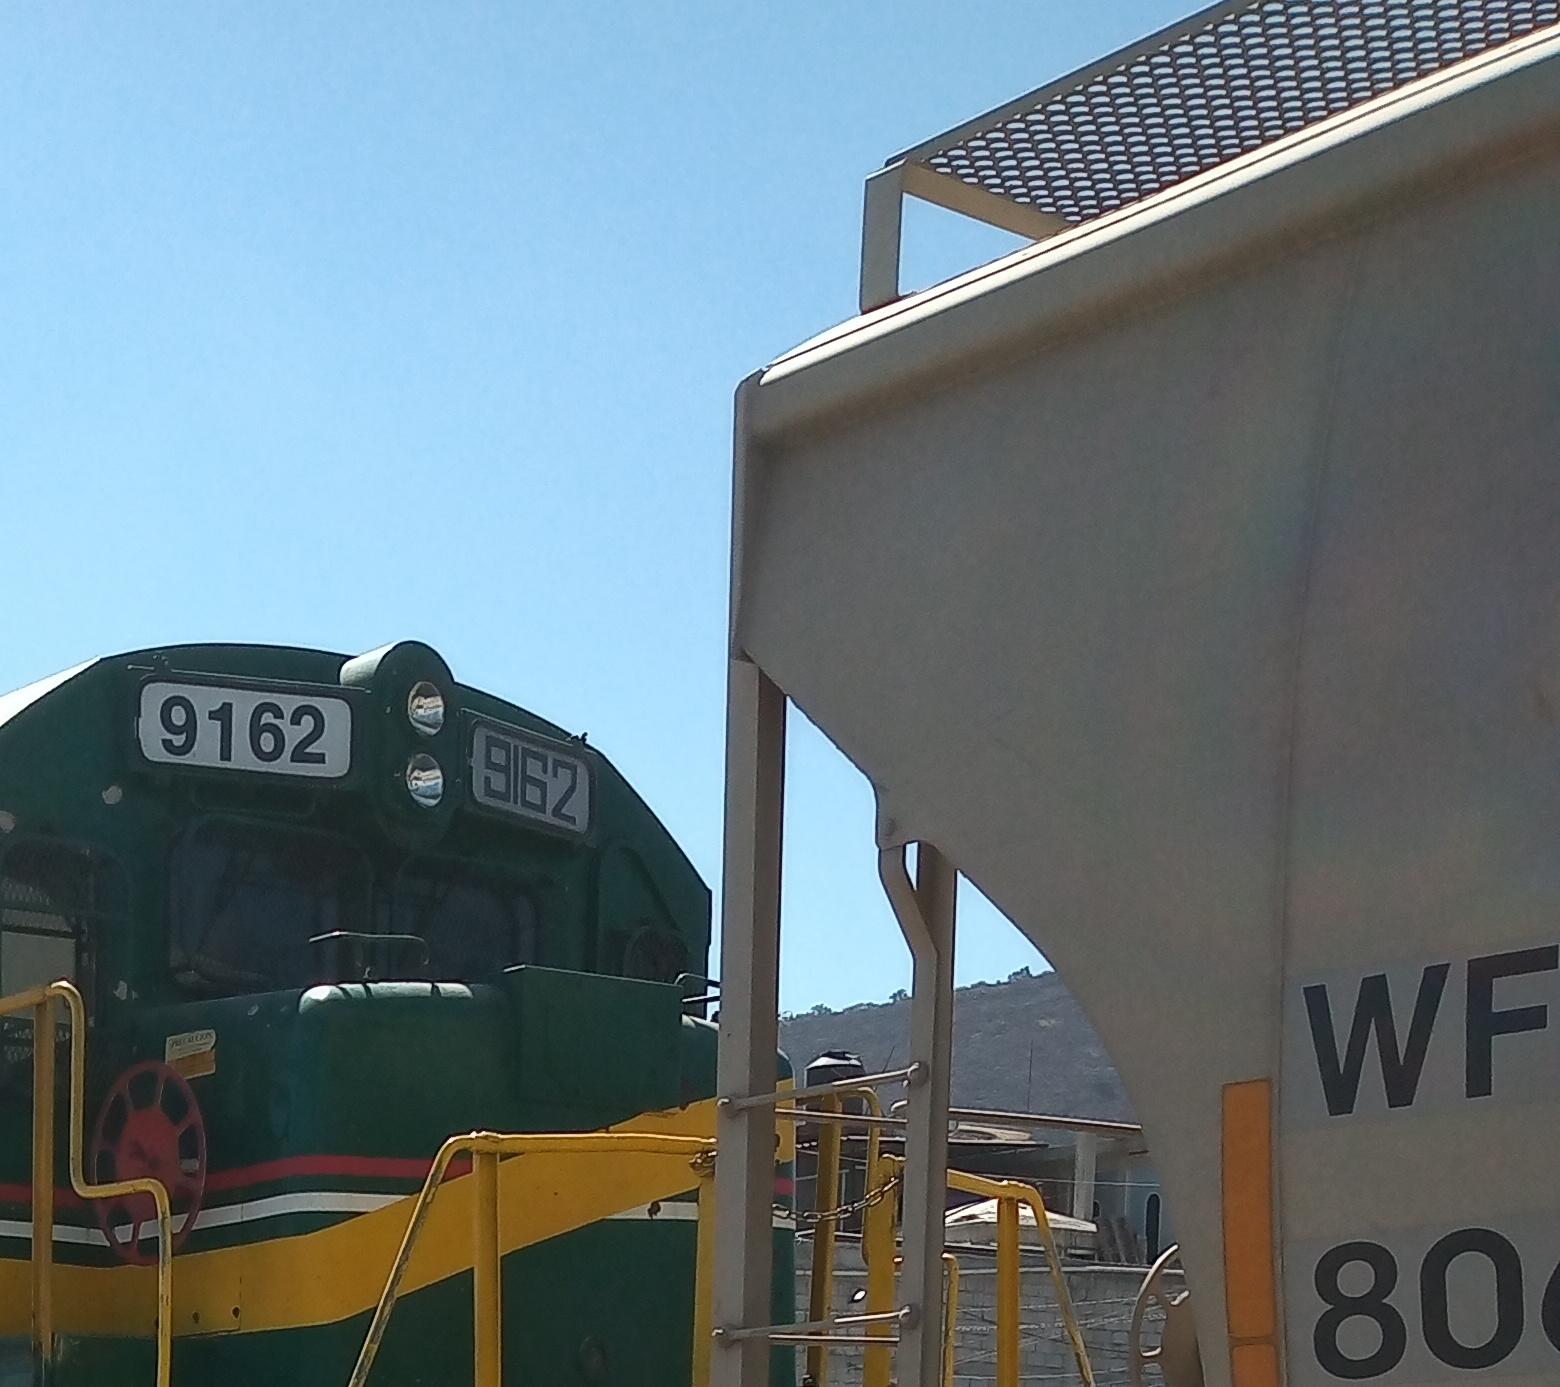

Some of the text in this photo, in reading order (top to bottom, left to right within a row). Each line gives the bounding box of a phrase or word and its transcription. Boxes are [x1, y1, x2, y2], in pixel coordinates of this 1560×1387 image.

[159, 694, 327, 764] 9162
[484, 735, 578, 825] 9162
[1303, 944, 1559, 1116] WF
[1313, 1228, 1560, 1379] 80
